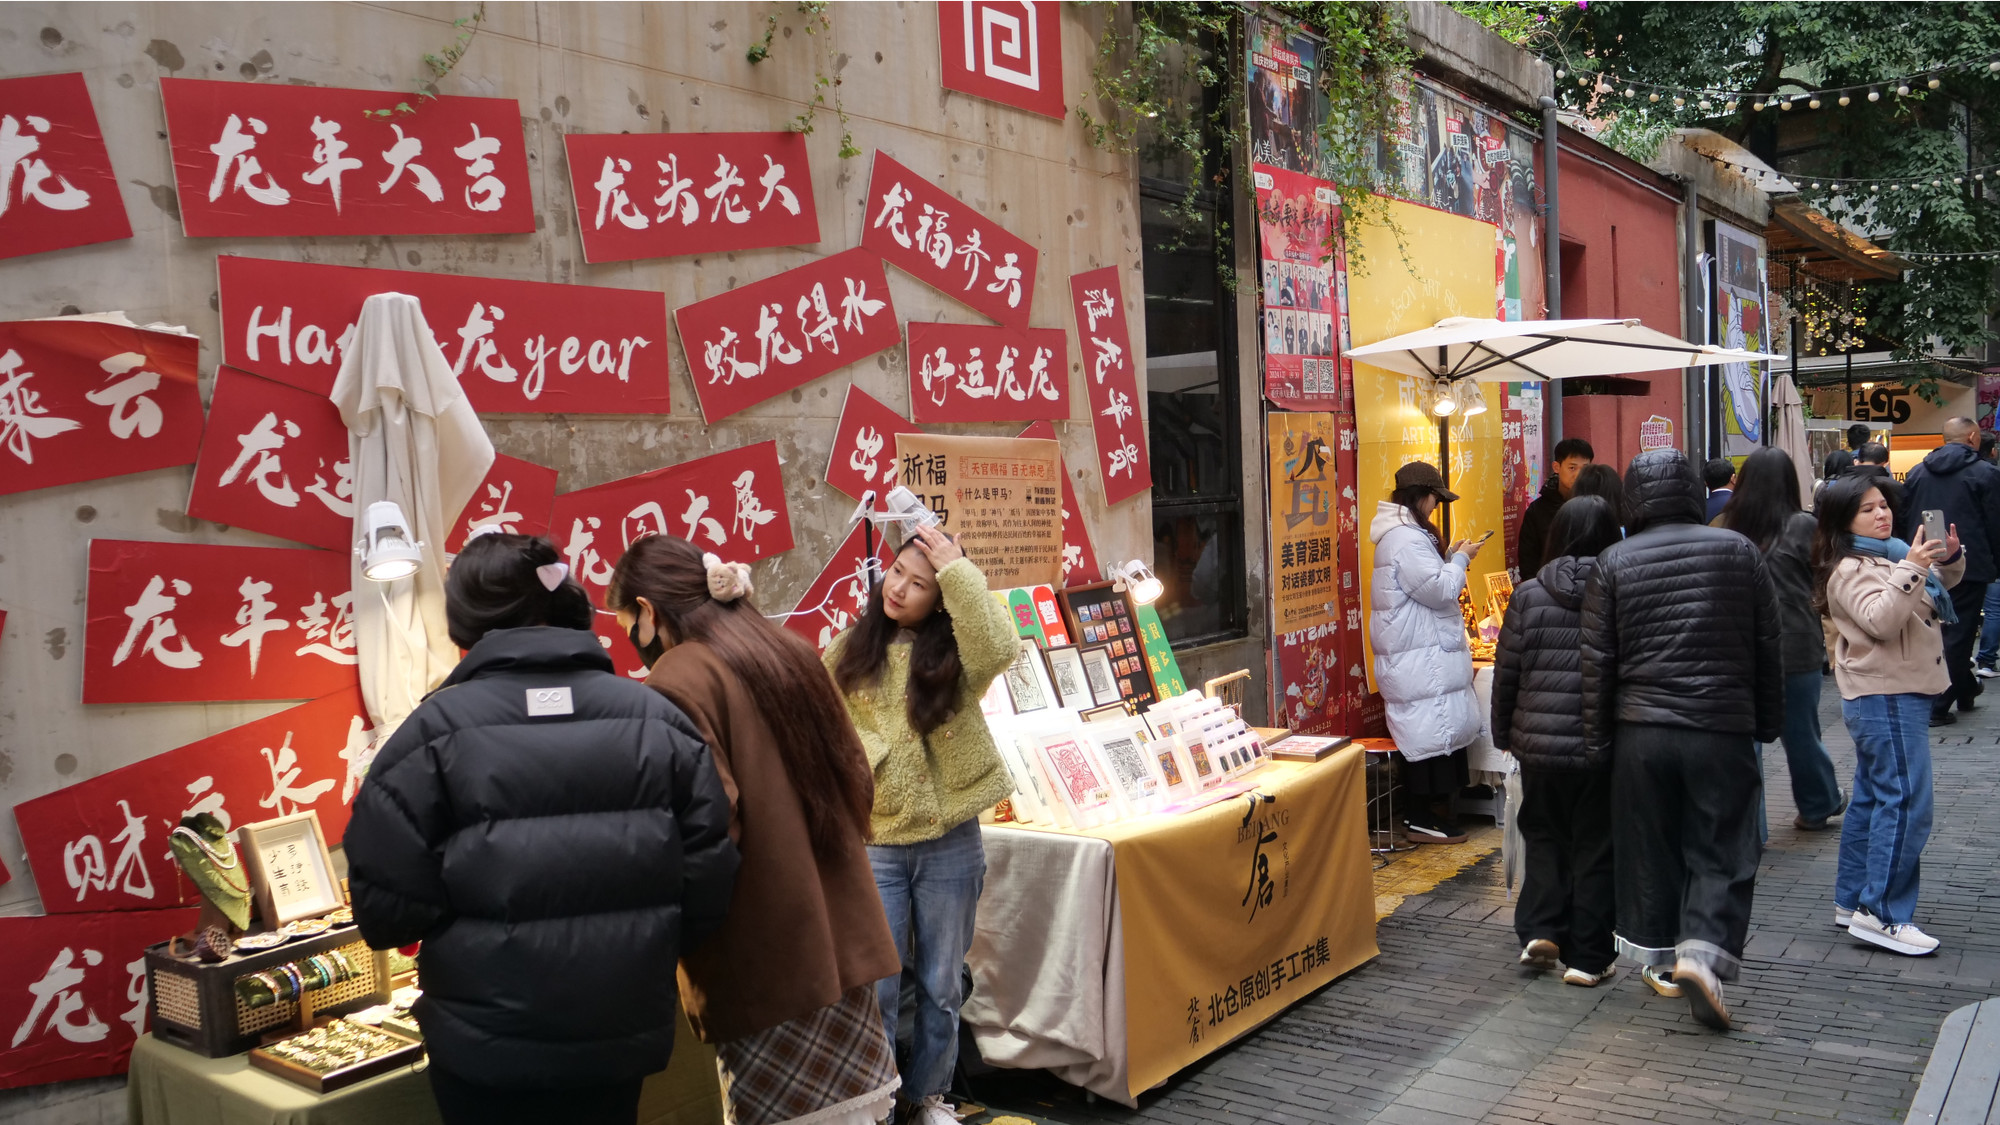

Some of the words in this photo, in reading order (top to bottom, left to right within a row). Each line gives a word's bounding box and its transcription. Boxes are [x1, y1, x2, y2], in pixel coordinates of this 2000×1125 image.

[209, 113, 506, 216] 龙年大吉
[594, 154, 801, 230] 龙头老大
[874, 181, 1022, 308] 龙福齐天
[704, 277, 887, 385] 蛟龙得水
[522, 333, 652, 400] year
[850, 426, 899, 483] 出
[1402, 426, 1425, 445] ART
[1428, 425, 1474, 443] SESON
[903, 453, 947, 487] 祈福
[971, 462, 1008, 477] 天官赐福
[1011, 464, 1045, 478] 百无禁忌
[915, 494, 949, 527] 马
[1281, 537, 1331, 569] 美育浸润
[1281, 566, 1331, 591] 对话瓷都文明
[1207, 936, 1331, 1027] 北仓原创手工市集
